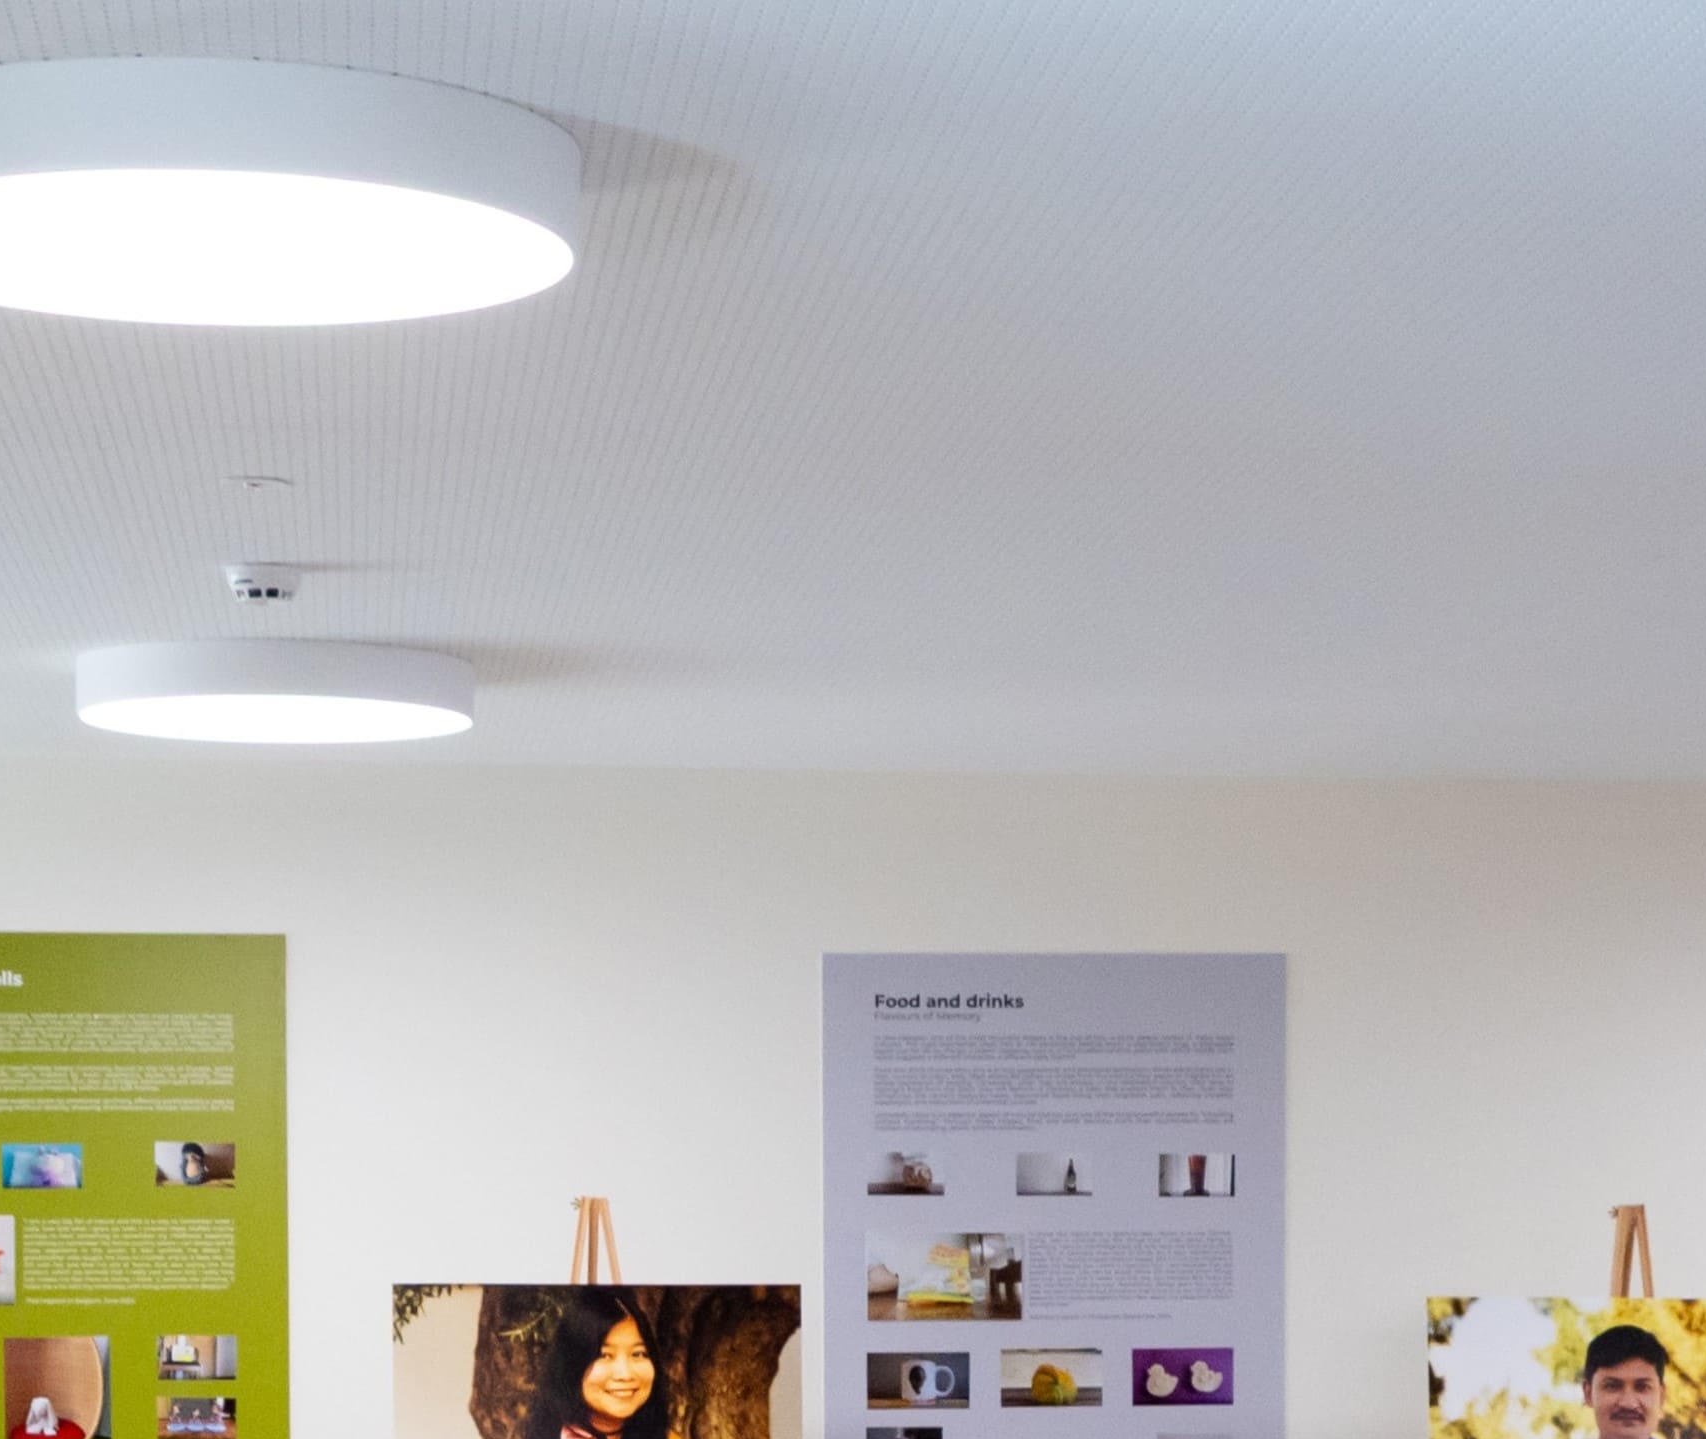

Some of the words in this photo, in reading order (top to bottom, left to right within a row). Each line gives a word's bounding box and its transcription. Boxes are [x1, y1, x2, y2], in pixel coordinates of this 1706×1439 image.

[874, 994, 920, 1009] Food
[926, 994, 960, 1009] and
[966, 992, 1025, 1009] drinks
